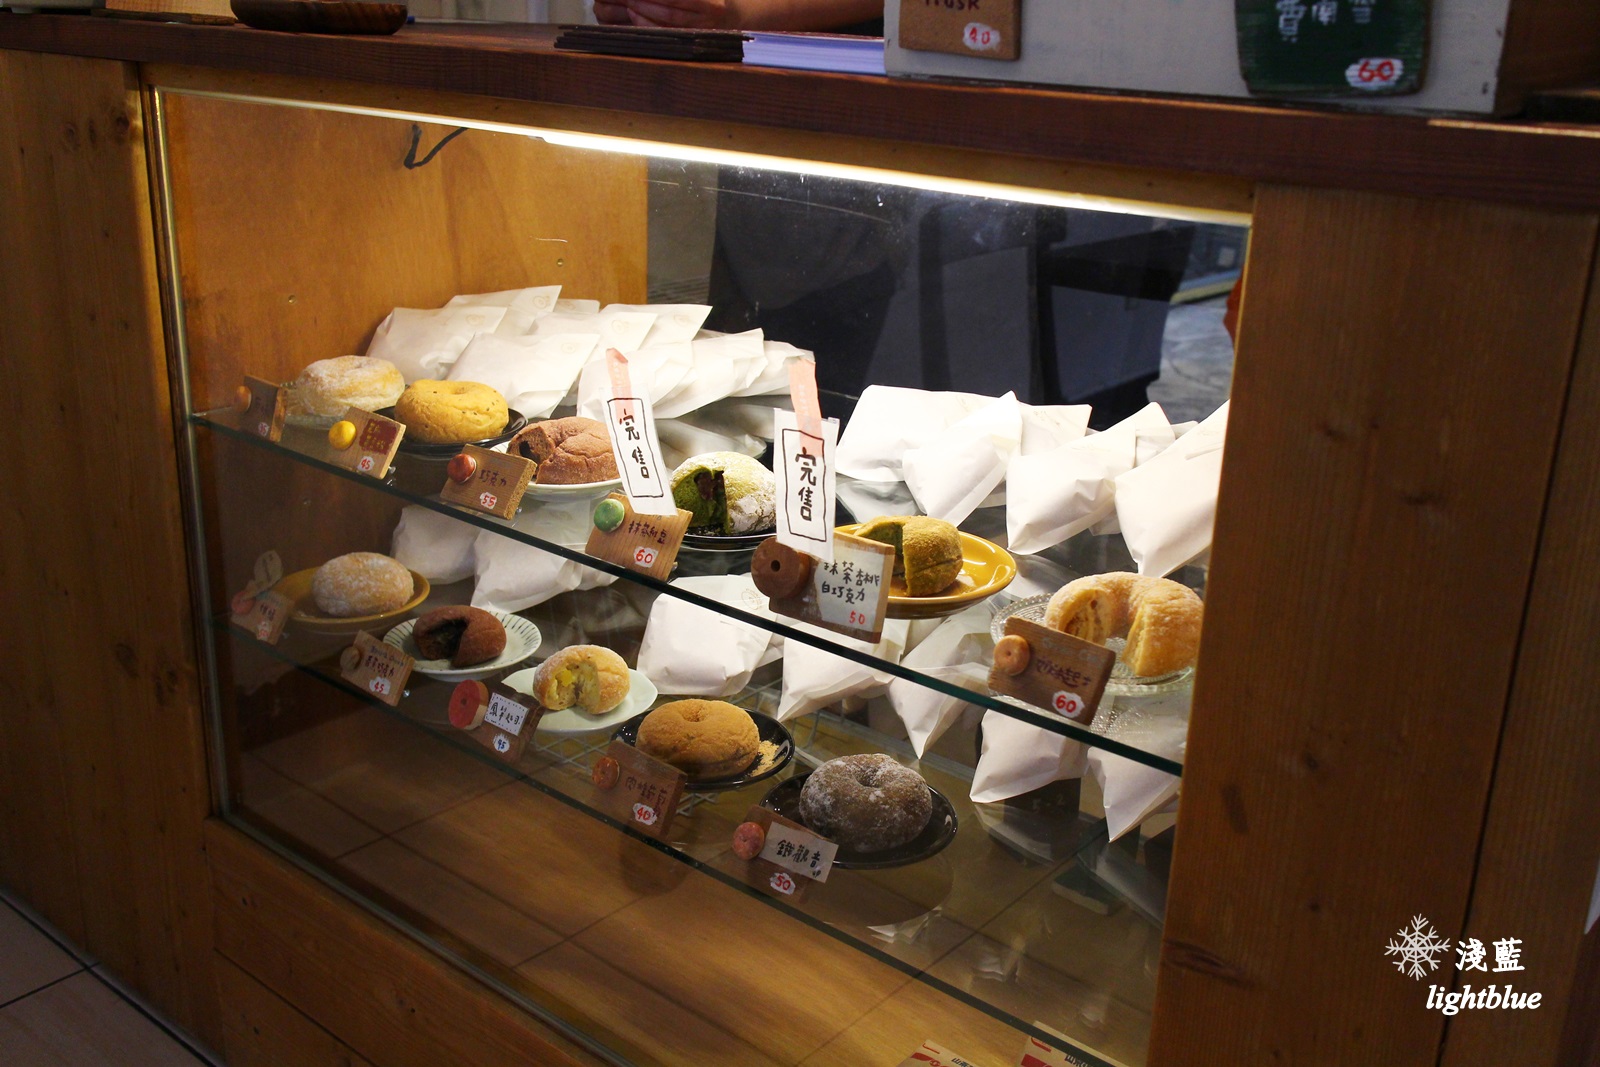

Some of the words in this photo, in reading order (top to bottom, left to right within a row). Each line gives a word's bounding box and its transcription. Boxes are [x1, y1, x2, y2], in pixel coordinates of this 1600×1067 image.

[969, 27, 990, 44] 40
[1358, 60, 1394, 82] 60
[619, 408, 650, 479] 完售
[479, 469, 507, 487] 巧克力
[795, 446, 817, 521] 完售
[482, 495, 495, 507] 55
[635, 549, 653, 564] 60
[821, 581, 866, 604] 白巧克力
[849, 610, 866, 625] 50
[1055, 695, 1077, 713] 60
[637, 807, 651, 820] 40
[776, 839, 821, 868] 鐵觀音
[775, 875, 791, 891] 50
